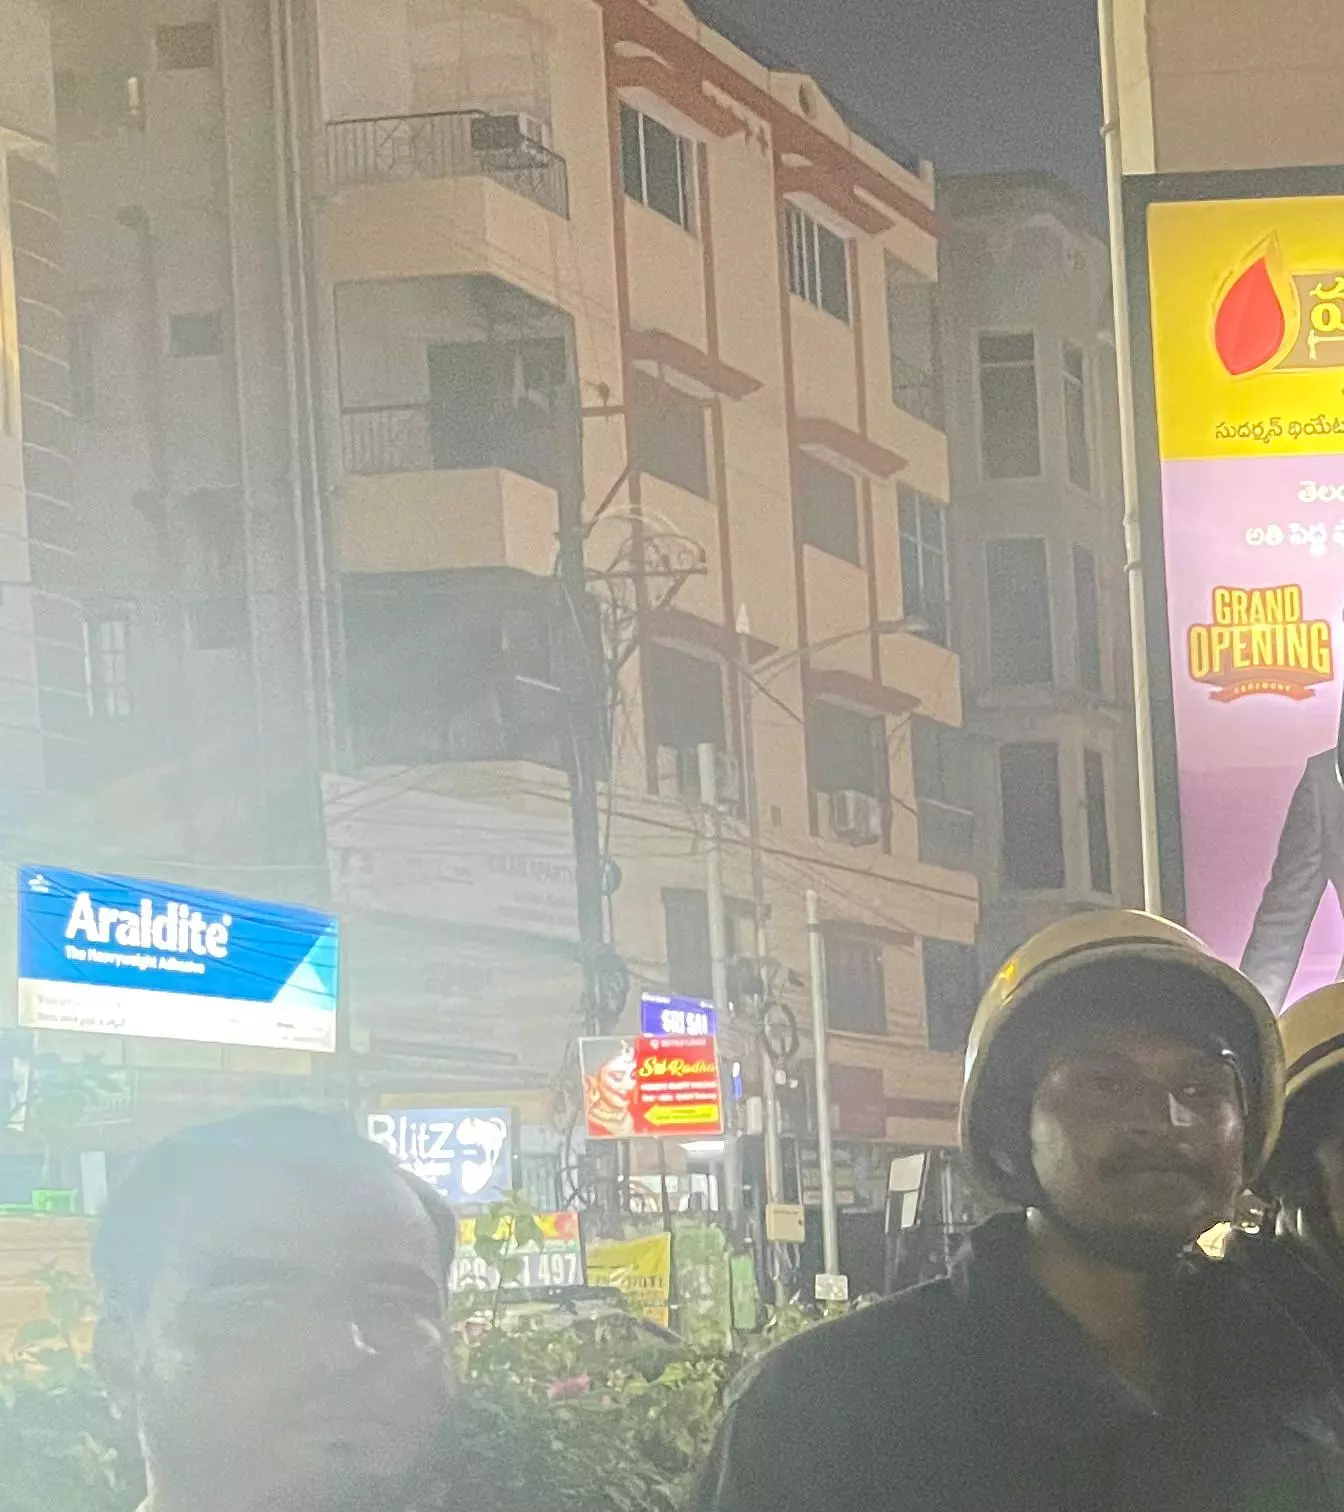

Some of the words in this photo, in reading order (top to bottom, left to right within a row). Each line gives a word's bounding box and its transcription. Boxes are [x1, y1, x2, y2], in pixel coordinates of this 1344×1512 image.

[1213, 585, 1301, 625] GRAND
[1190, 621, 1332, 679] OPENING
[65, 891, 228, 958] Araldite
